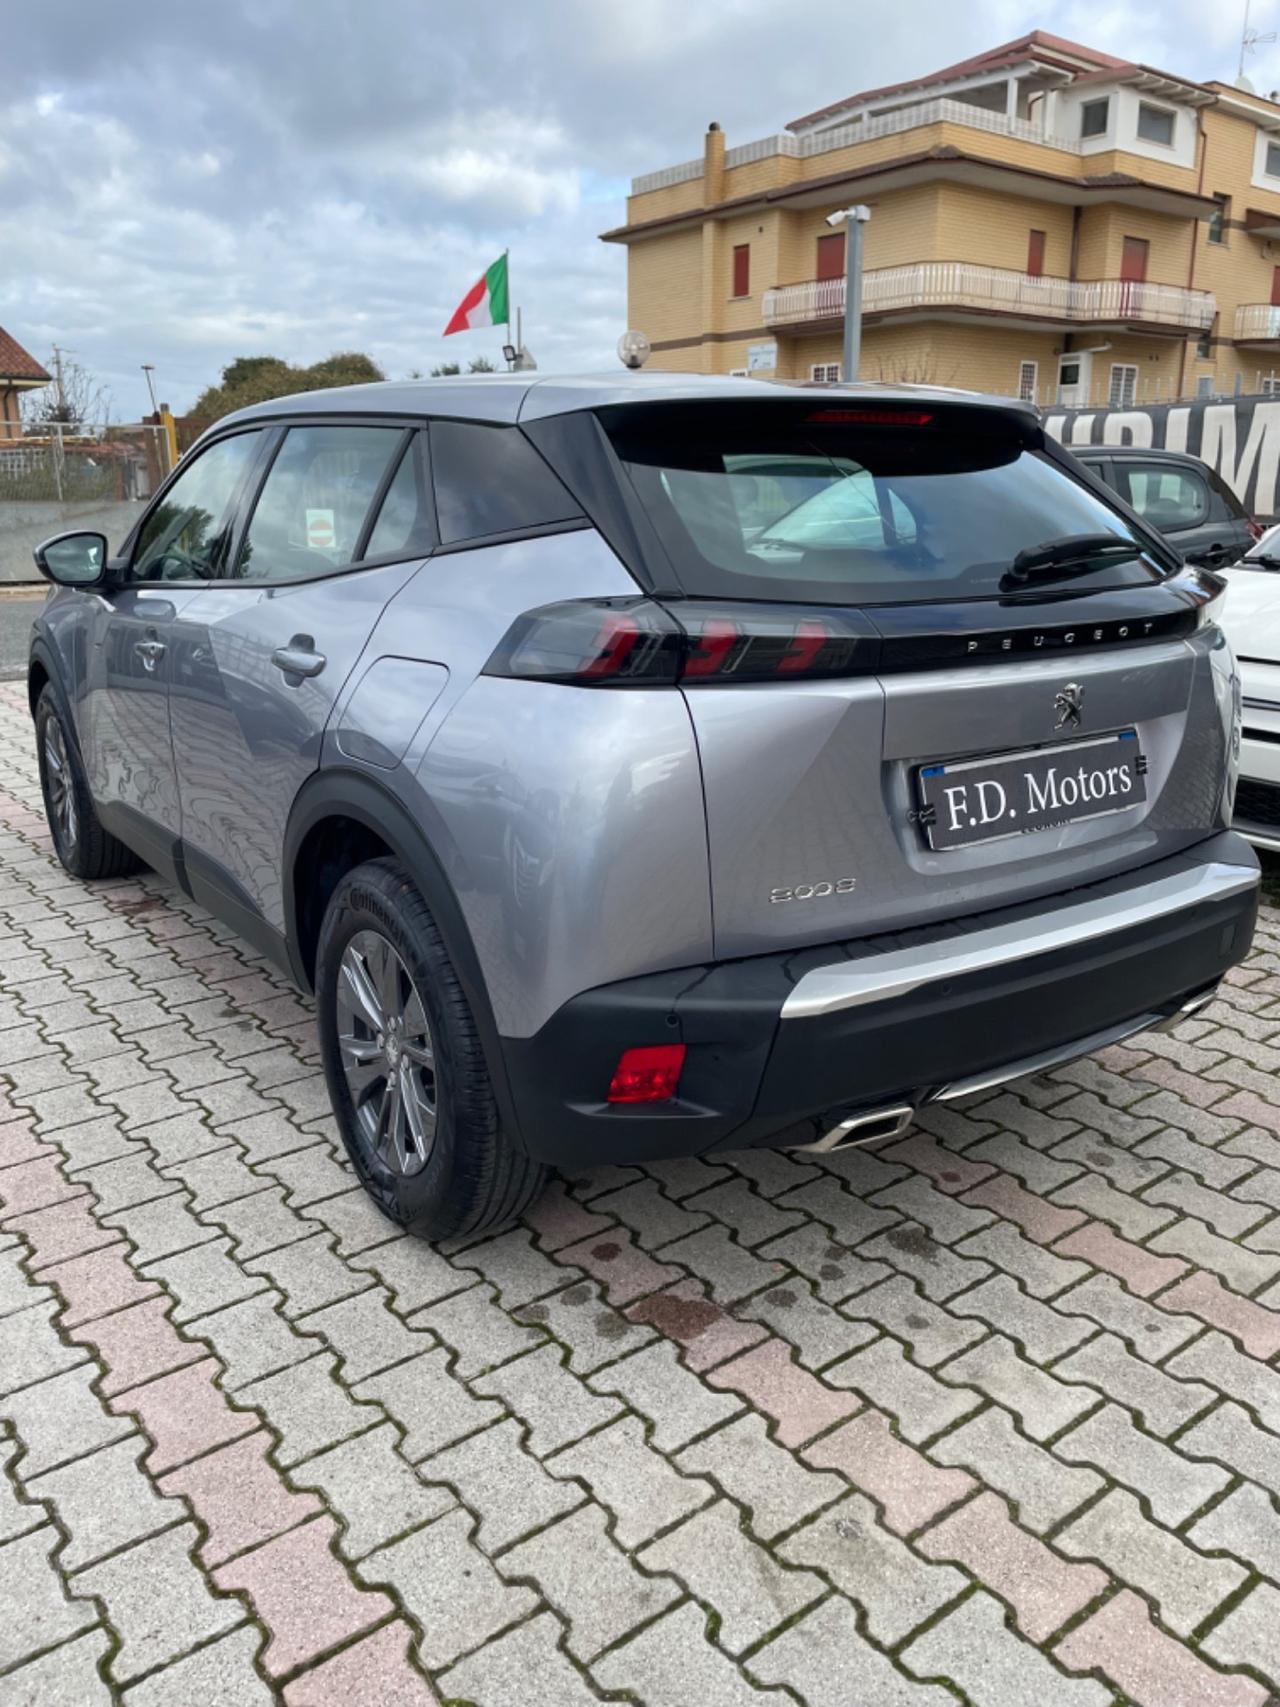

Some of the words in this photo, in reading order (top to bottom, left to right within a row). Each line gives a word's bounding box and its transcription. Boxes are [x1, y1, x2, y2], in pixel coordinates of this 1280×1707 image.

[968, 622, 1152, 653] PEUGEOT
[943, 780, 1017, 831] F.D.
[1024, 764, 1133, 814] Motors
[770, 877, 856, 904] 2008
